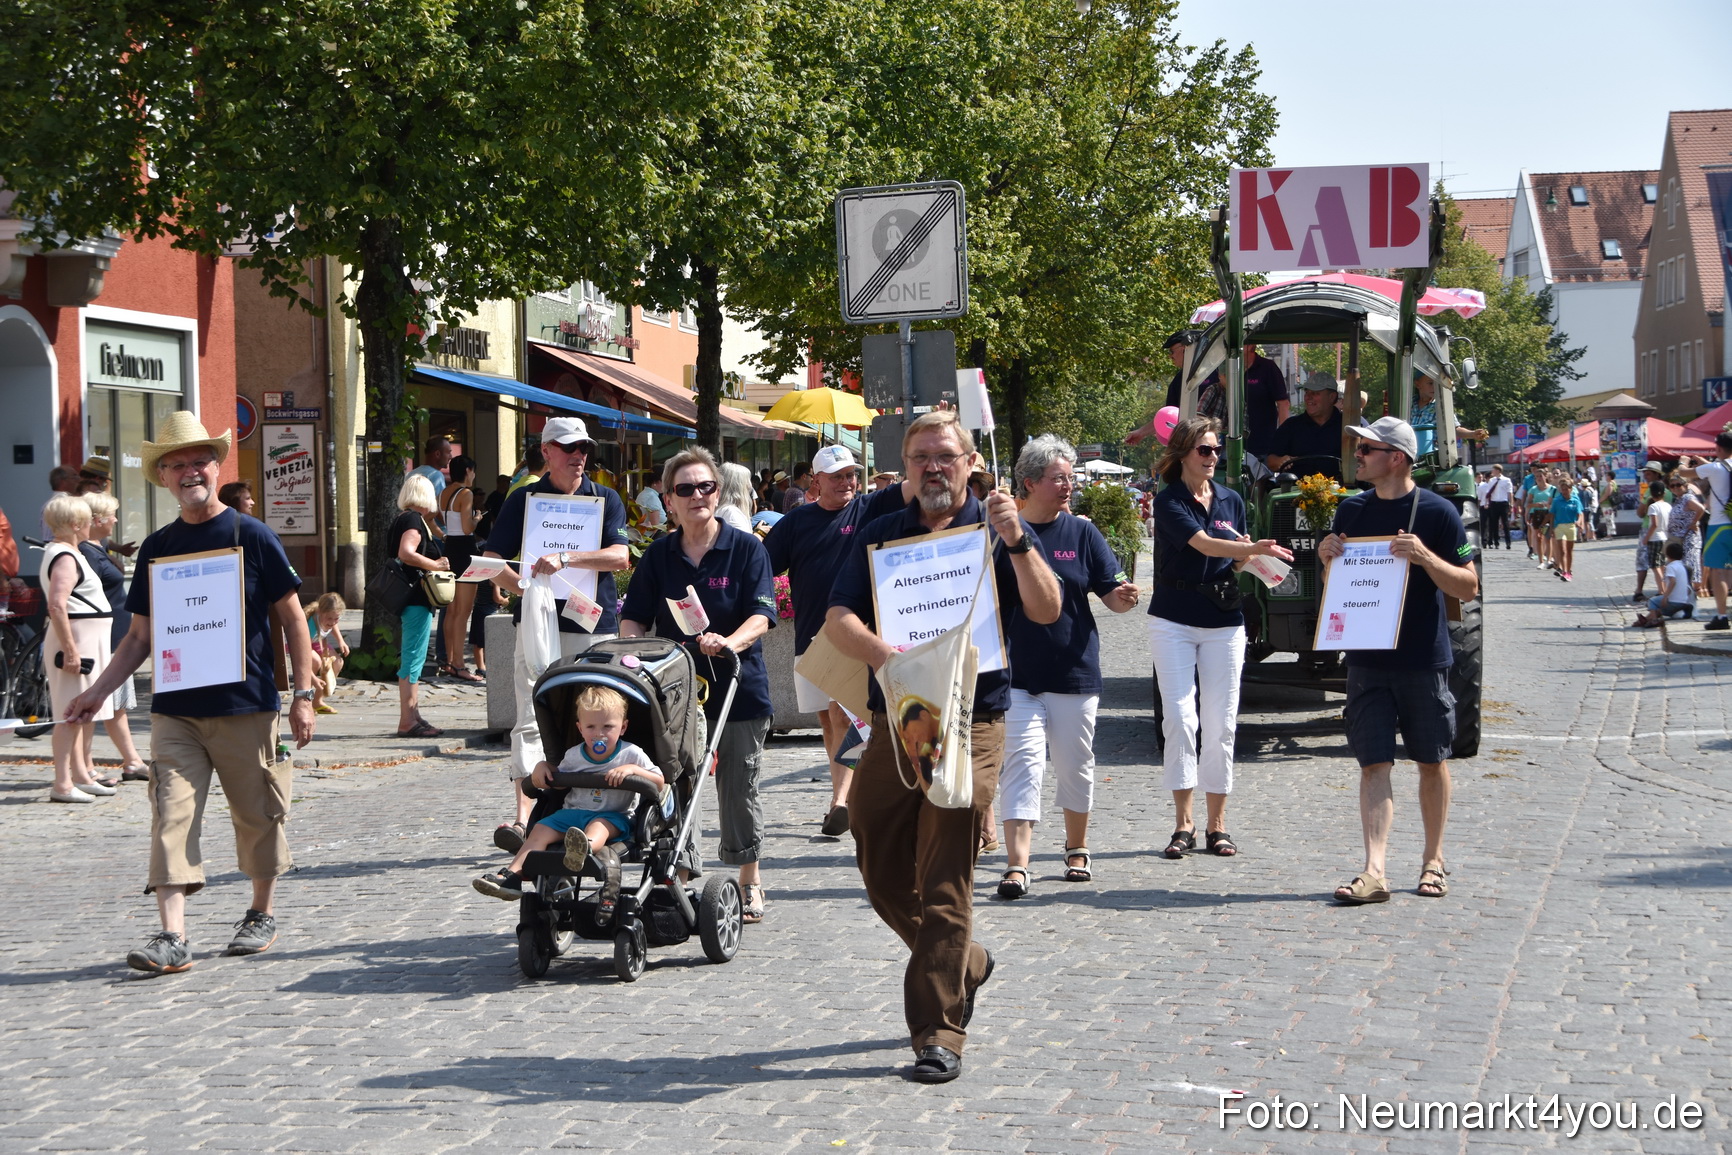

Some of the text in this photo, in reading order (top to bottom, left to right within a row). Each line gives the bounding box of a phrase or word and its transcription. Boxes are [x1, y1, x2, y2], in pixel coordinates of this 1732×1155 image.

[1239, 167, 1421, 267] KAB
[876, 282, 931, 303] ZONE
[100, 342, 163, 381] fielmann
[267, 409, 319, 419] Bockwirtsgasse
[265, 458, 313, 480] VENEZIA
[542, 521, 584, 530] Gerechter
[543, 541, 580, 550] Lohn für
[1053, 550, 1076, 558] KAB
[1343, 557, 1394, 566] Mit Steuern
[708, 577, 730, 587] KAB
[894, 565, 971, 588] Altersarmut
[1350, 578, 1380, 588] richtig
[185, 596, 208, 607] TTIP
[897, 595, 973, 615] verhindern:
[1342, 600, 1380, 608] steuern!
[167, 618, 227, 635] Nein danke!
[909, 627, 947, 641] Rente
